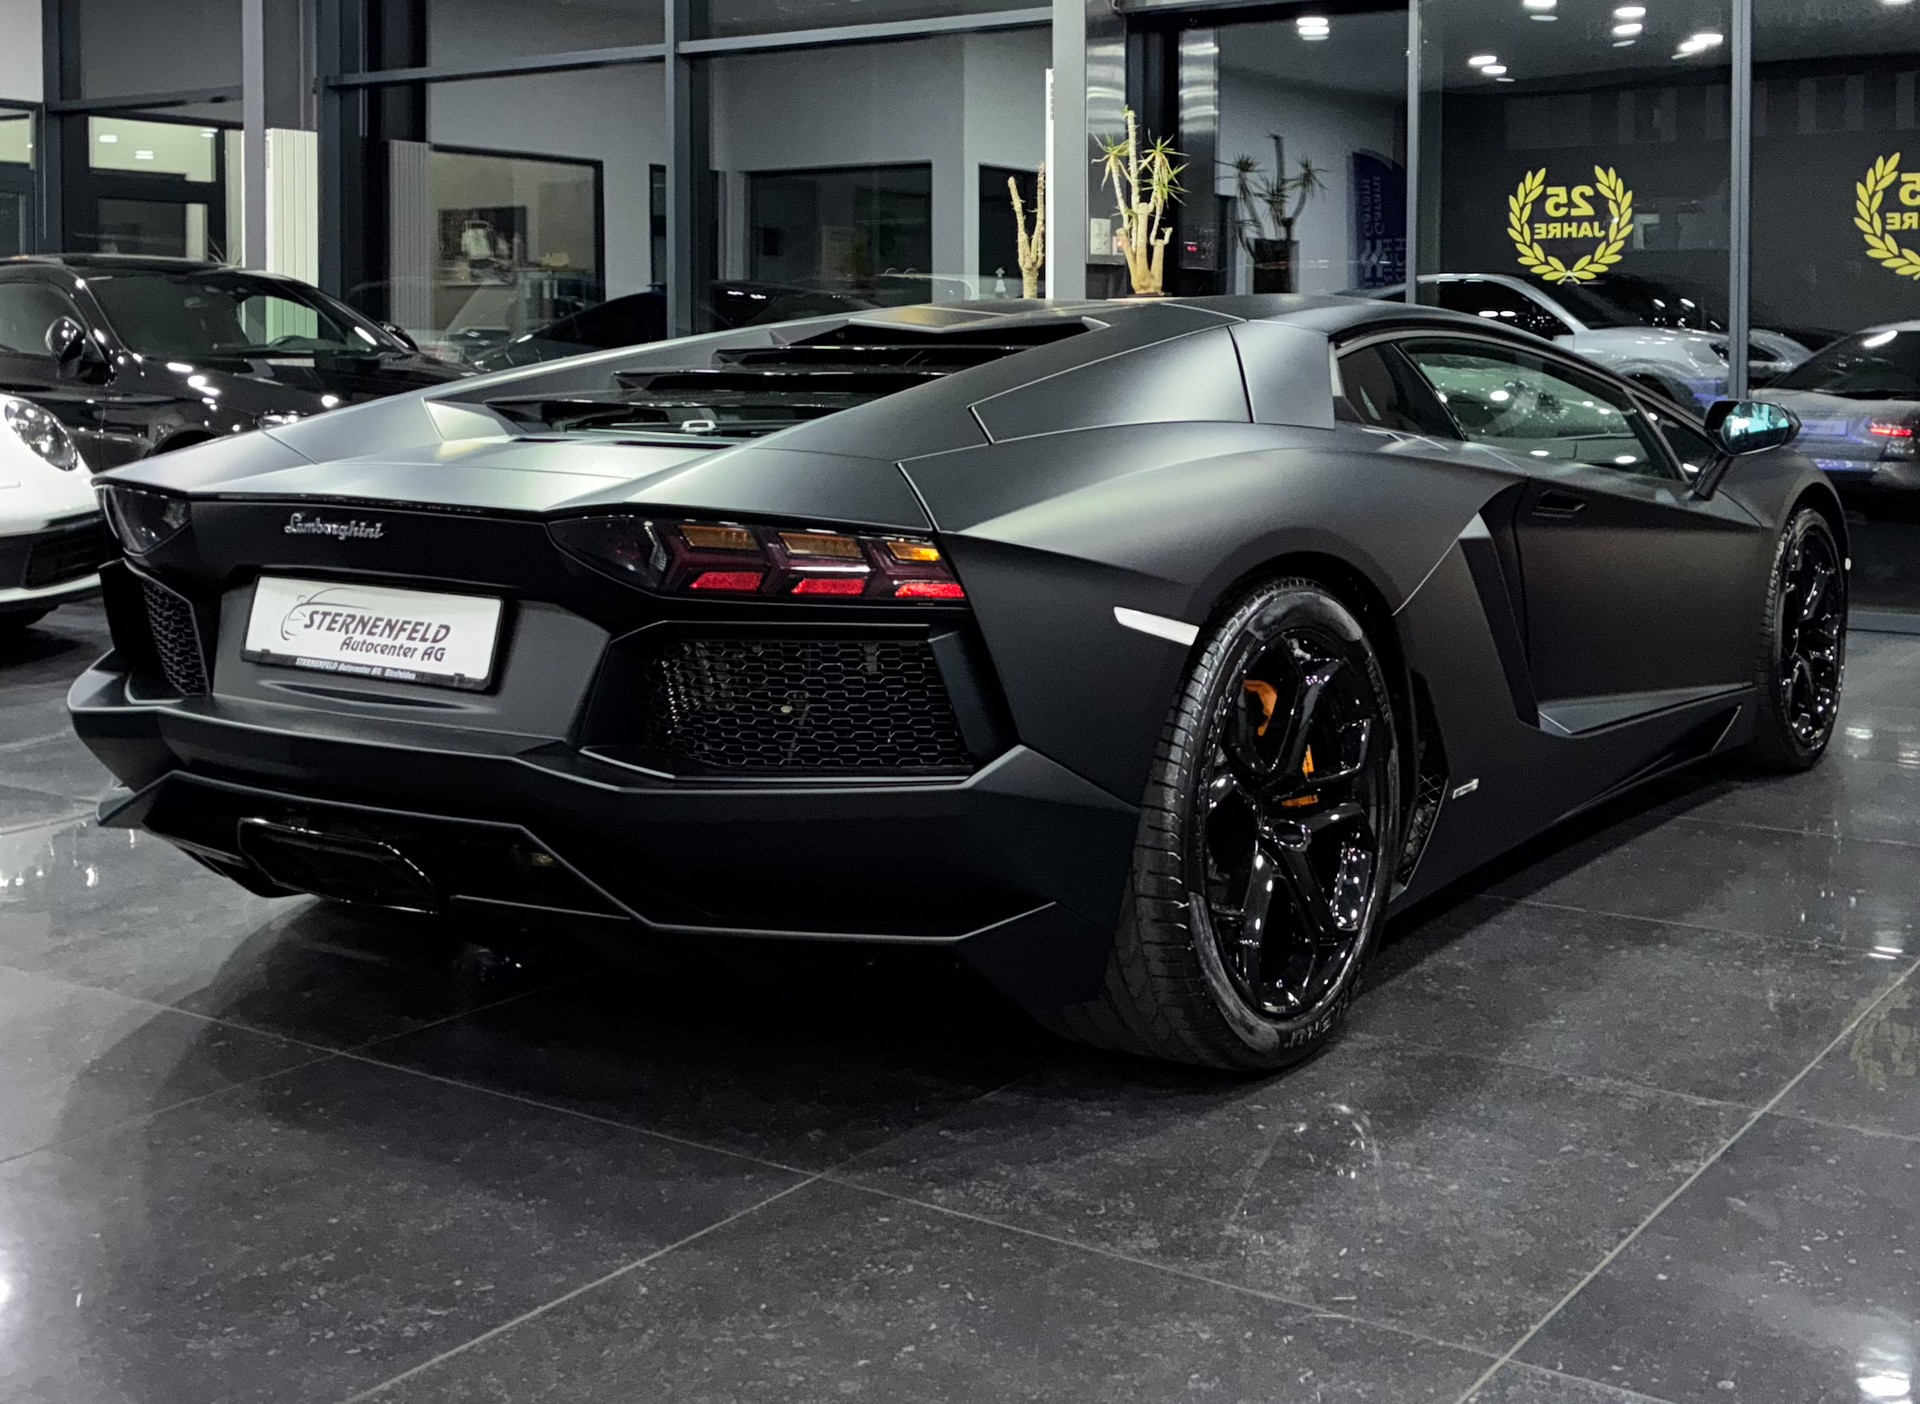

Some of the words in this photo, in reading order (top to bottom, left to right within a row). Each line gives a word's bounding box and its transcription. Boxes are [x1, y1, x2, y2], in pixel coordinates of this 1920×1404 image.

[284, 512, 385, 541] Lamborghini
[303, 610, 451, 644] STERNENFELD
[340, 636, 419, 659] Autocenter
[420, 645, 446, 662] AG
[295, 657, 338, 670] STERNENFELD
[337, 663, 372, 674] Autocenter
[371, 666, 382, 676] AG
